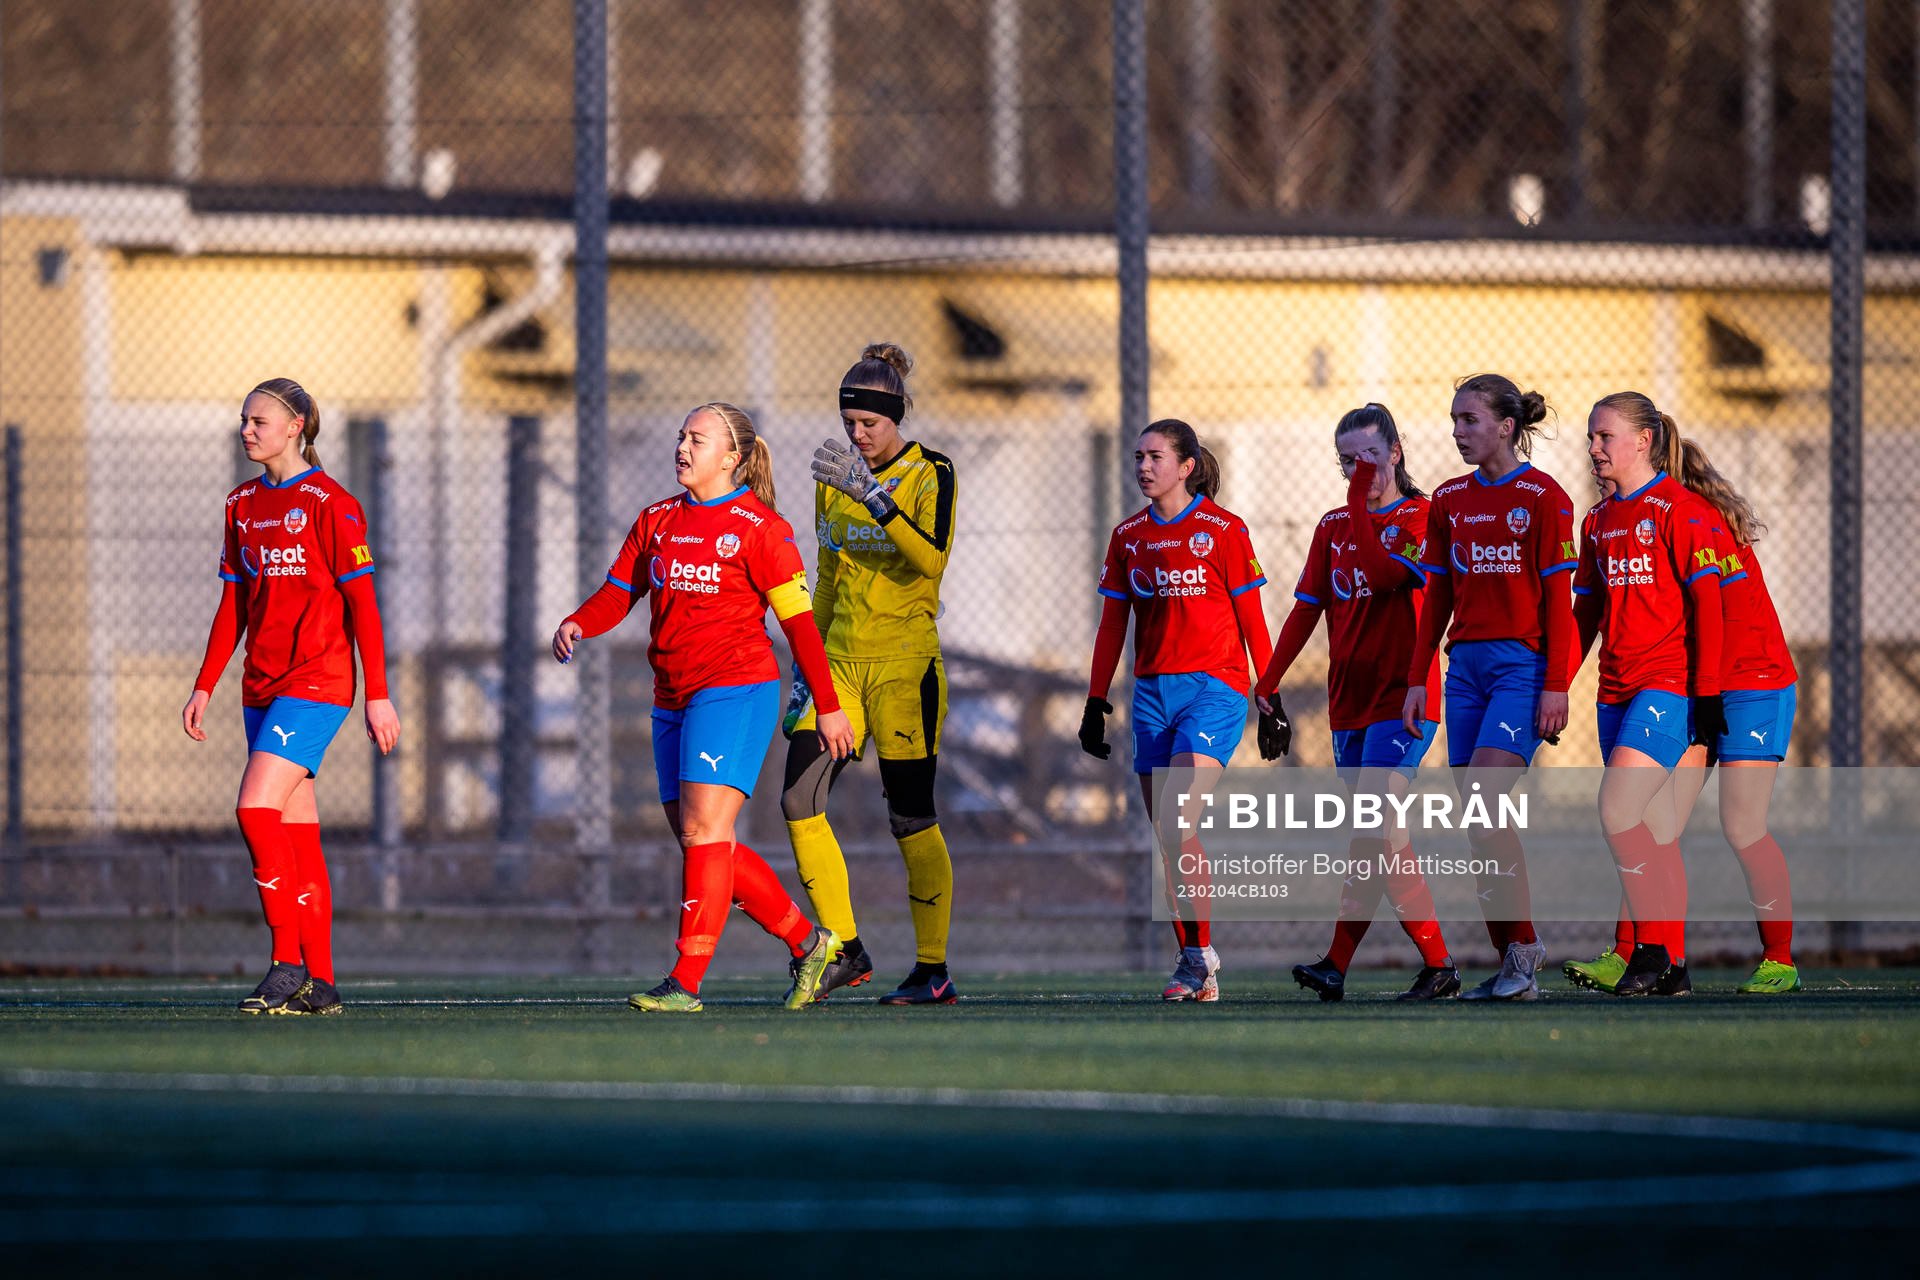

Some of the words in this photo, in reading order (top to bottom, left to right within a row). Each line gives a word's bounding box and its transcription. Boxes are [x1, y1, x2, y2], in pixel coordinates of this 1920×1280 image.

[847, 522, 886, 540] bea
[260, 543, 306, 564] beat
[1471, 541, 1522, 561] beat
[670, 558, 722, 582] beat
[1472, 562, 1522, 574] diabetes
[1608, 553, 1653, 574] beat
[1155, 565, 1207, 586] beat
[1608, 573, 1654, 587] diabetes
[670, 579, 720, 594] diabetes
[1159, 586, 1207, 597] diabetes
